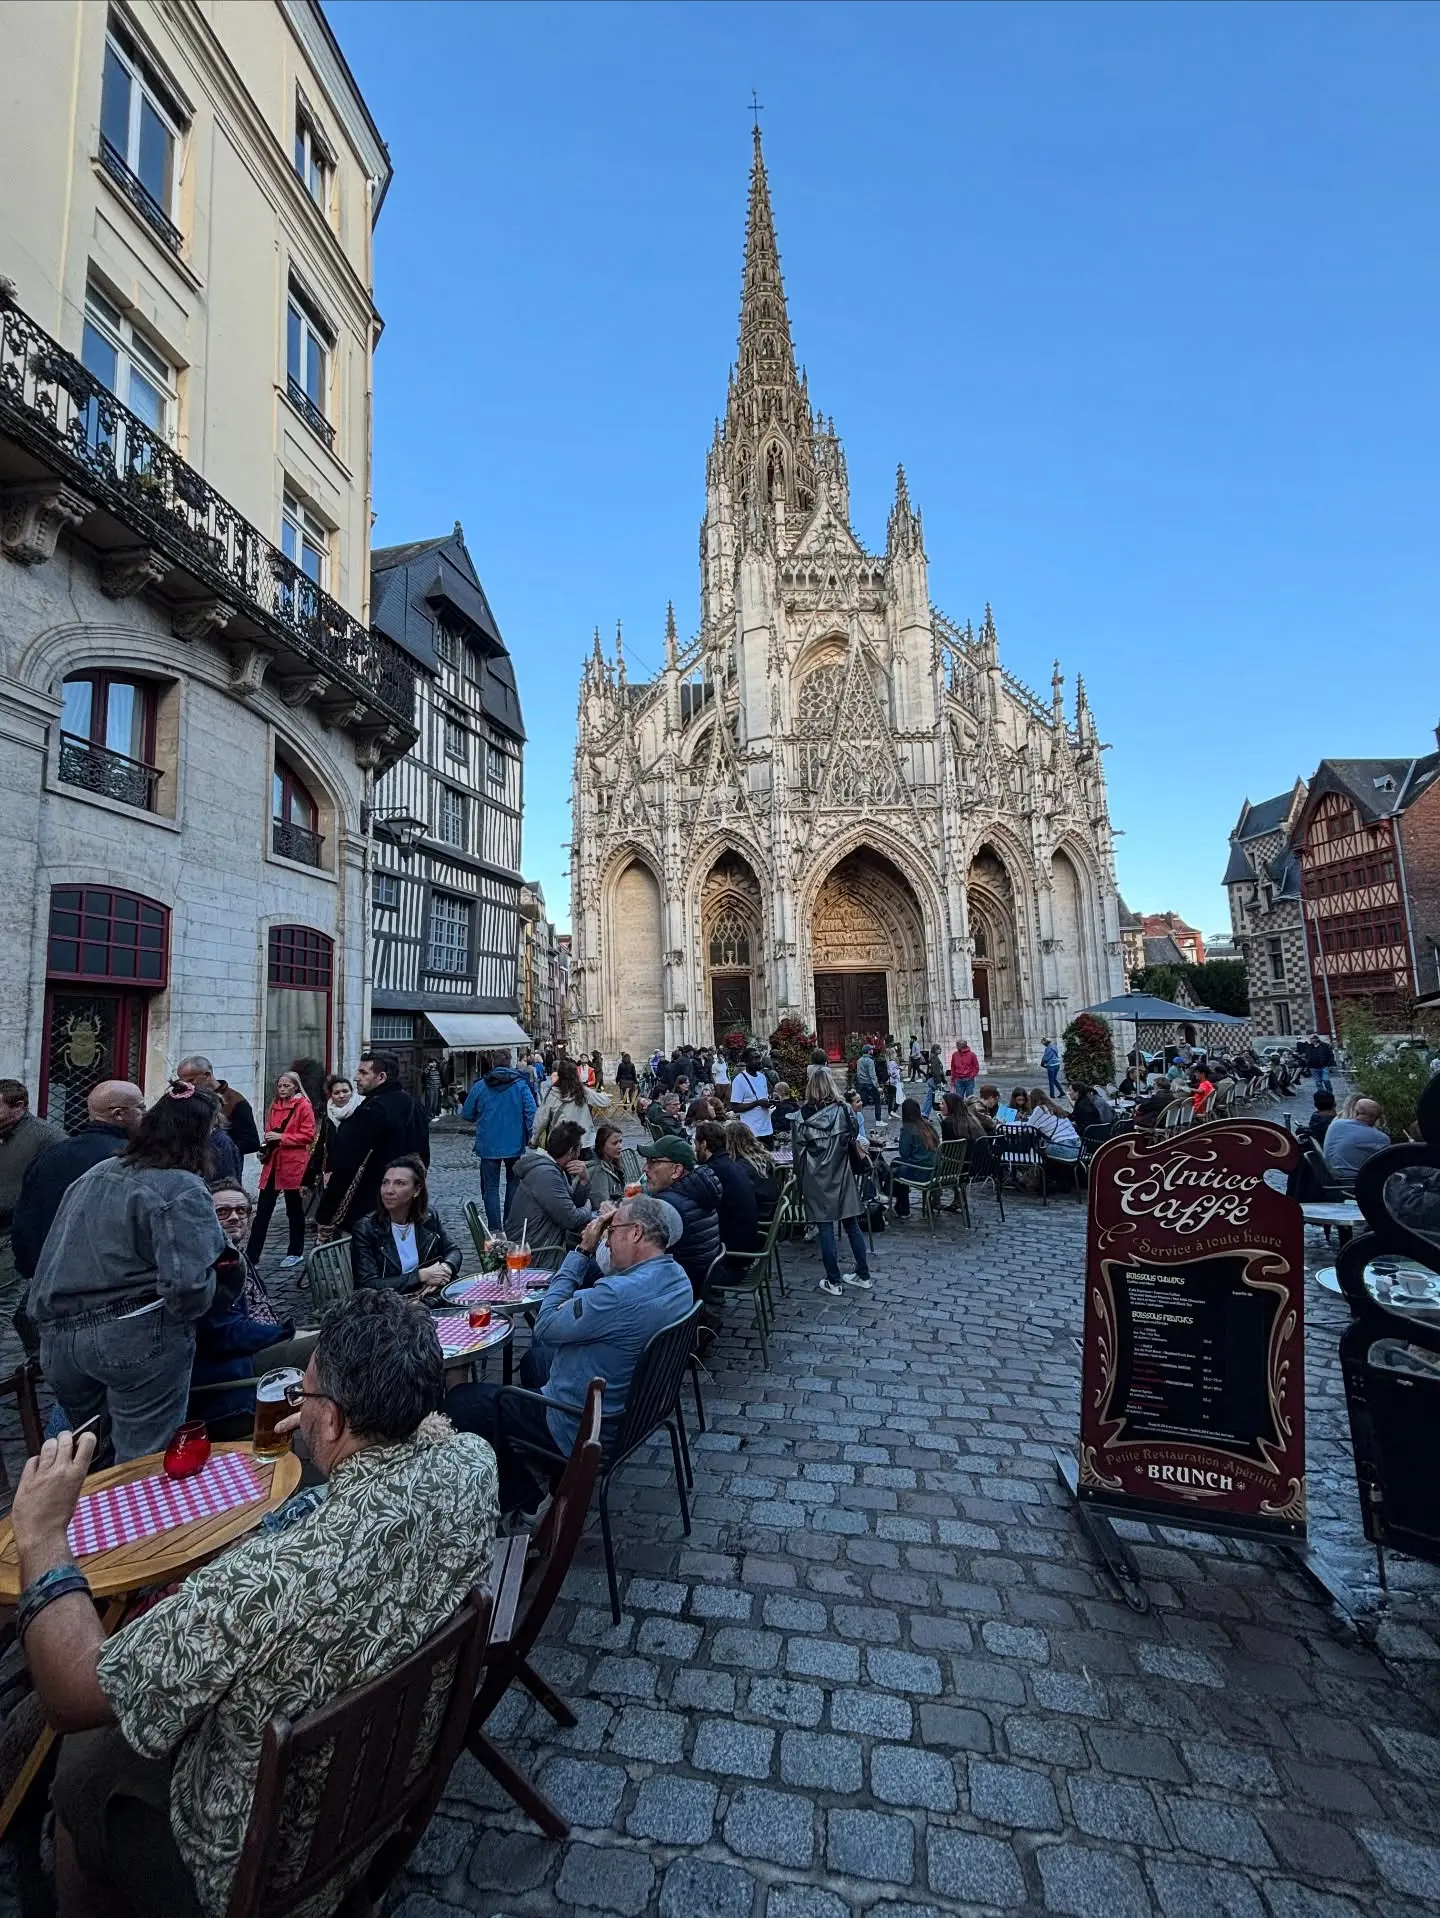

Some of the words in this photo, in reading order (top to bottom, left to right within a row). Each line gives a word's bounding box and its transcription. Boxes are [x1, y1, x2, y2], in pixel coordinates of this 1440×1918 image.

[1150, 1150, 1264, 1191] Antico
[1113, 1167, 1251, 1235] Caffé
[1133, 1237, 1191, 1257] Service
[1195, 1239, 1204, 1252] à
[1206, 1233, 1241, 1249] toute
[1243, 1227, 1282, 1248] heure
[1105, 1450, 1140, 1466] Petite
[1142, 1447, 1220, 1469] Restauration
[1147, 1464, 1233, 1491] BRUNCH
